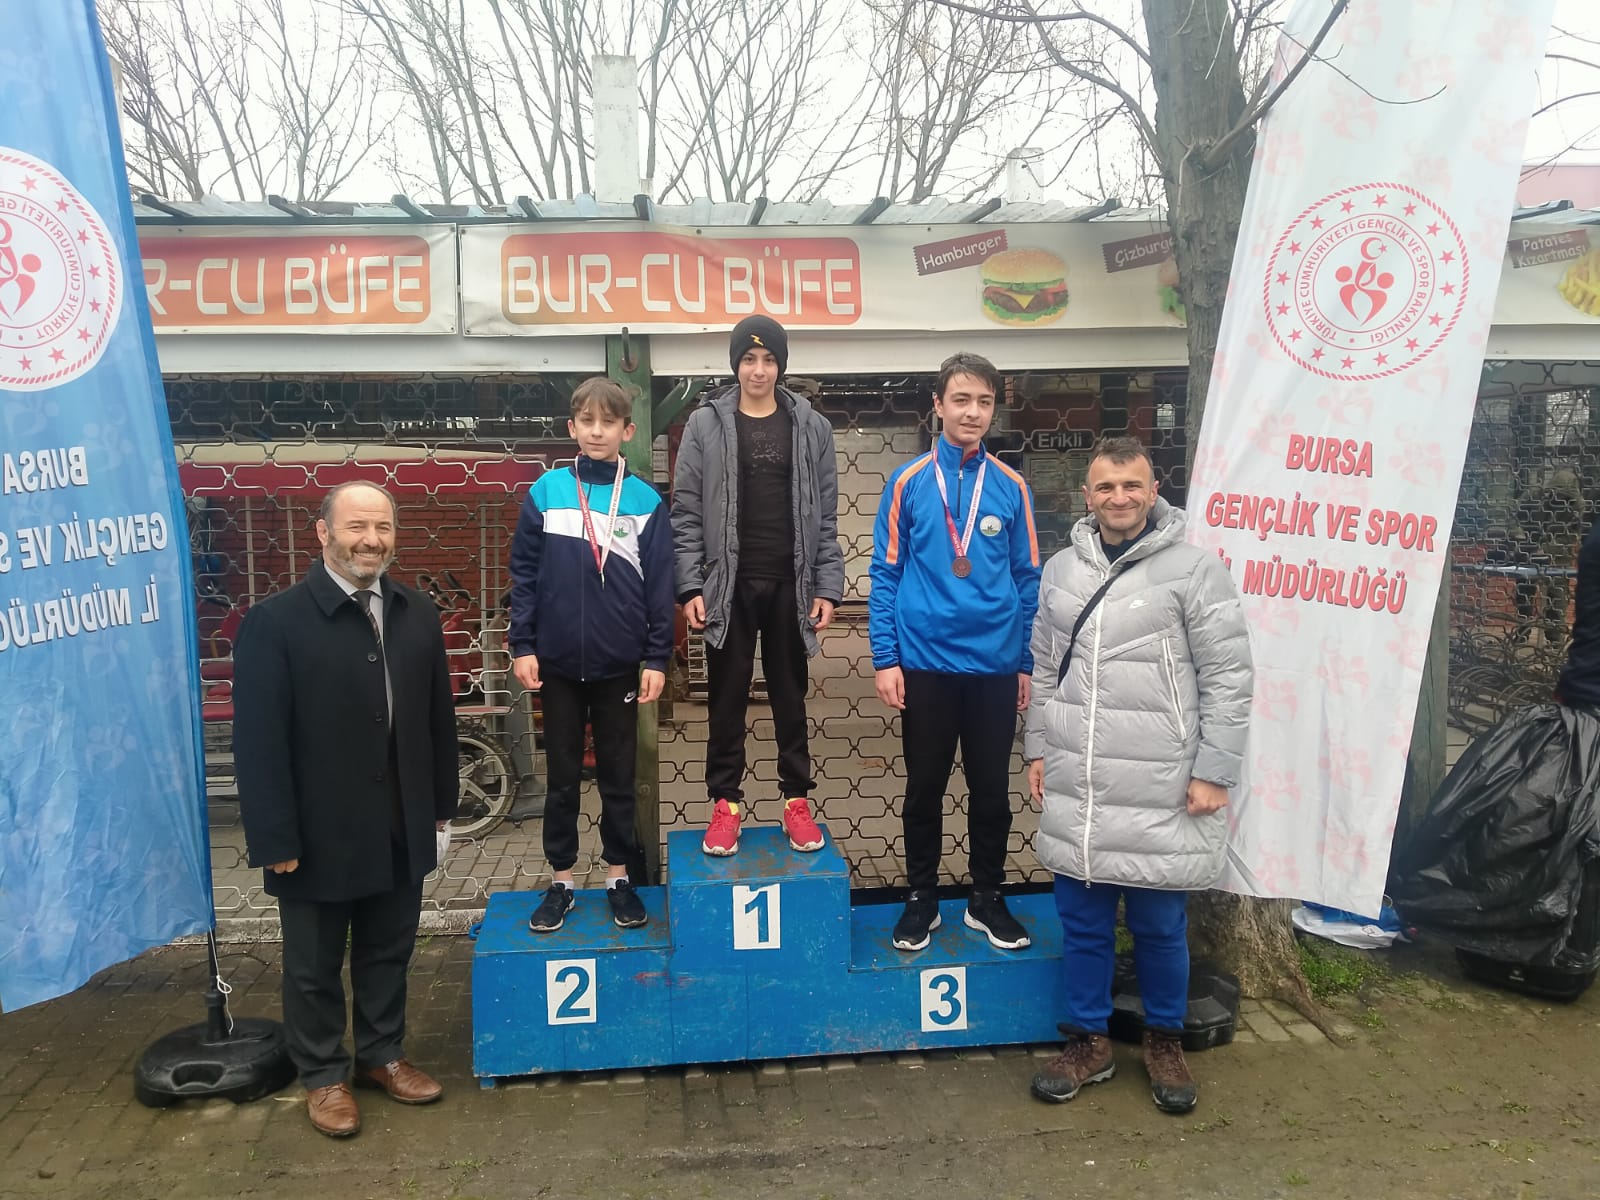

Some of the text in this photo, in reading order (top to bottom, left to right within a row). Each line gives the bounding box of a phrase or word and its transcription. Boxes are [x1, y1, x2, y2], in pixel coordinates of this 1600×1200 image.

[921, 235, 1002, 270] Hamburger
[1522, 233, 1573, 253] Patates
[284, 242, 425, 315] BÜFE
[507, 245, 855, 315] BUR-CU BÜFE
[1300, 219, 1430, 343] TÜRKİYE CUMHURİYETİ GENÇLİK VE SPOR BAKANLIĞI
[1038, 432, 1082, 448] Erikli
[1286, 433, 1373, 478] BURSA
[1205, 491, 1438, 553] GENÇLİK VE SPOR
[1243, 555, 1408, 615] MÜDÜRLÜĞÜ
[744, 893, 769, 944] 1
[555, 965, 591, 1019] 2
[927, 974, 962, 1028] 3
